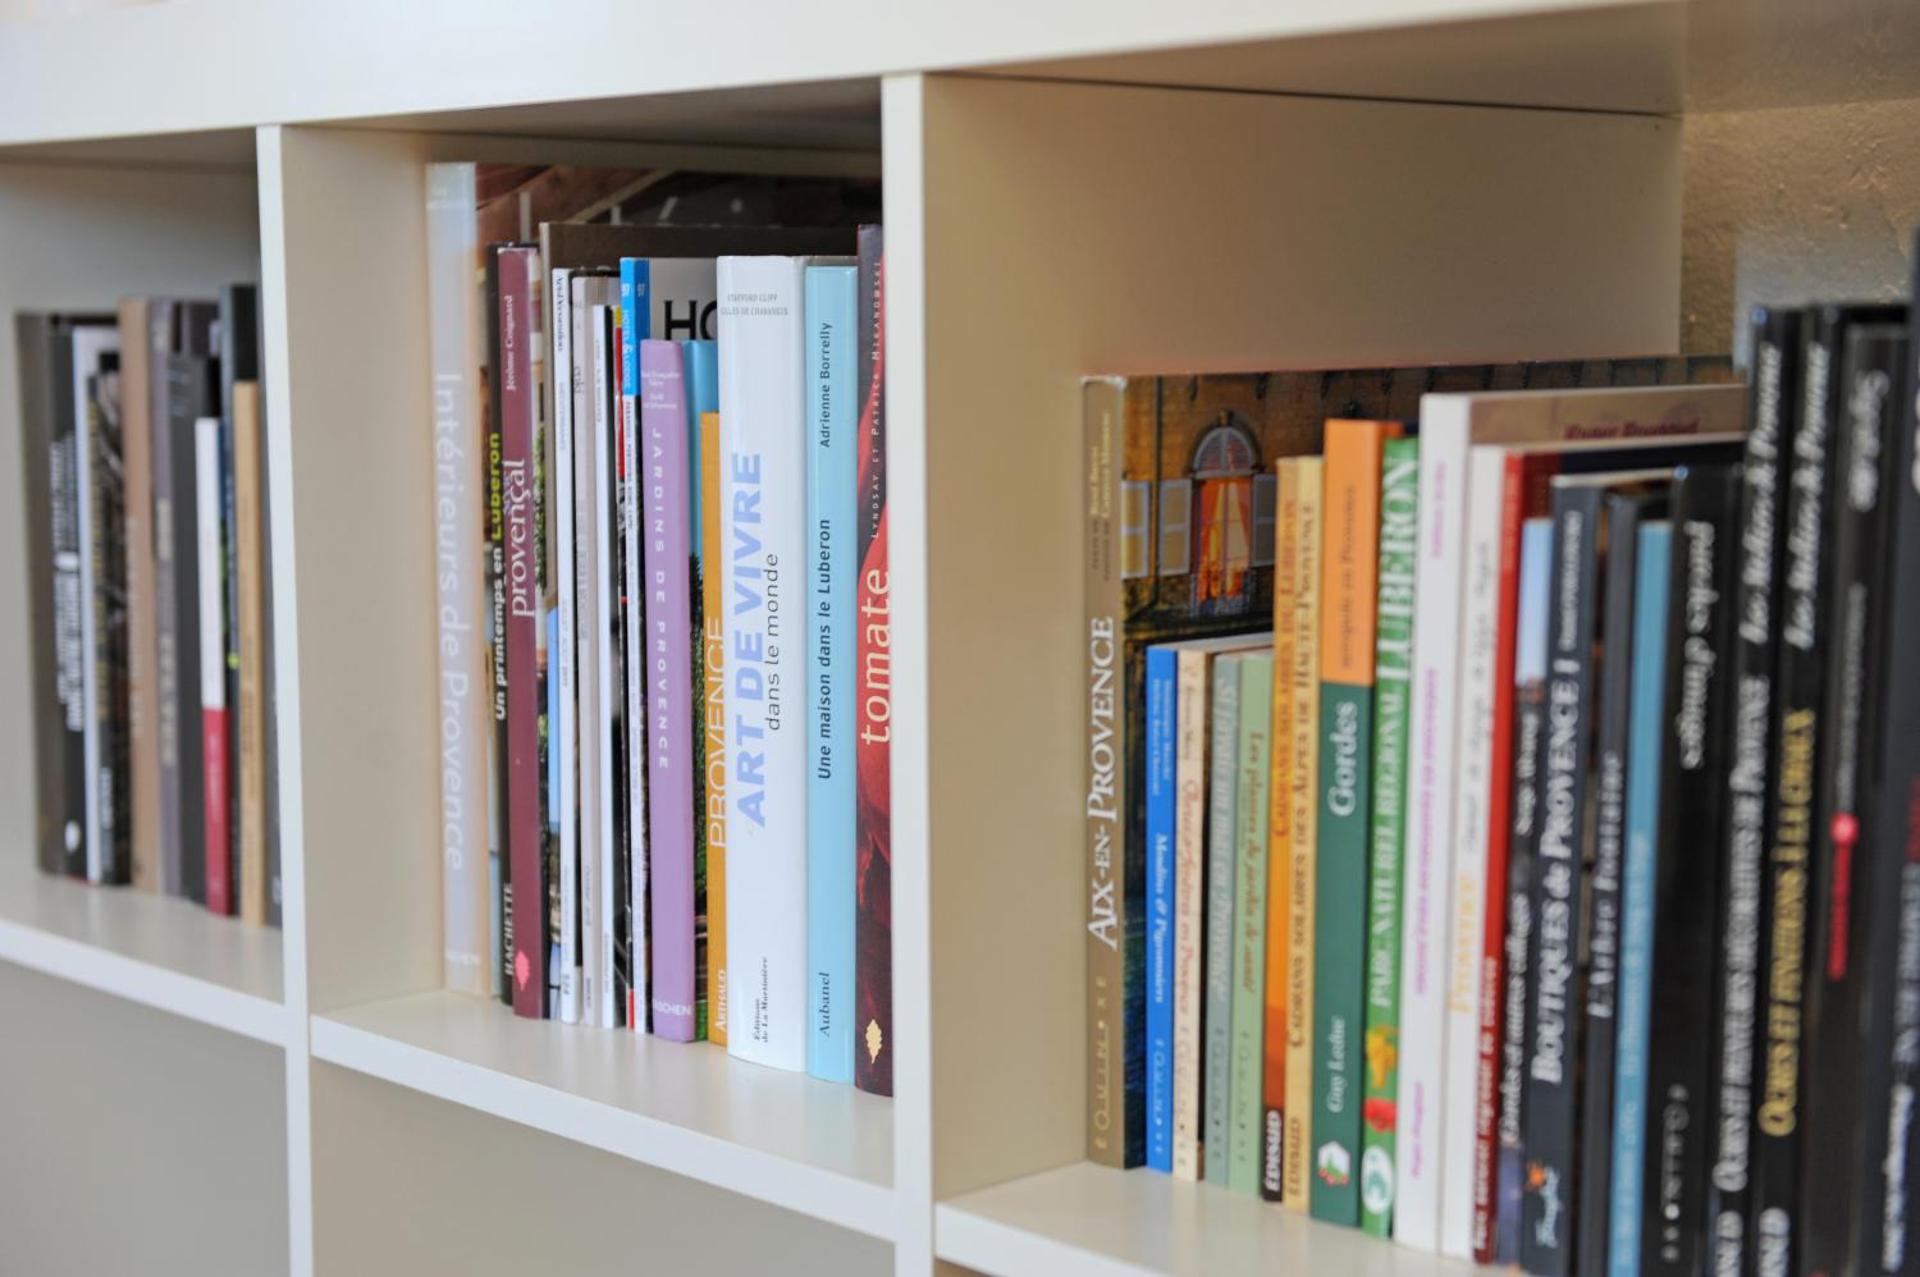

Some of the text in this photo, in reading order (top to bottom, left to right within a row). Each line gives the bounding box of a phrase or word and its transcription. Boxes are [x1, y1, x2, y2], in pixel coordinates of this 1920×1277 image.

[817, 322, 834, 448] Adrienne Borrelly
[437, 372, 469, 871] Intérieurs de Provence
[490, 432, 508, 720] Un printemps en Luberon
[502, 458, 535, 616] provençal
[653, 428, 668, 770] JARDINS DE PROVENCE
[1376, 458, 1418, 680] LUBERON
[732, 453, 765, 828] ART DE VIVRE
[762, 554, 782, 731] dans le monde
[816, 518, 832, 780] Une maison dans le Luberon
[860, 569, 890, 745] tomate
[708, 616, 726, 848] PROVENCE
[1327, 701, 1358, 817] Gordes
[1539, 681, 1579, 857] PROVENCE
[503, 882, 514, 976] HACHETTE
[1546, 861, 1571, 898] de
[818, 972, 830, 1038] Aubanel
[1530, 900, 1571, 1083] BOUTIQUES
